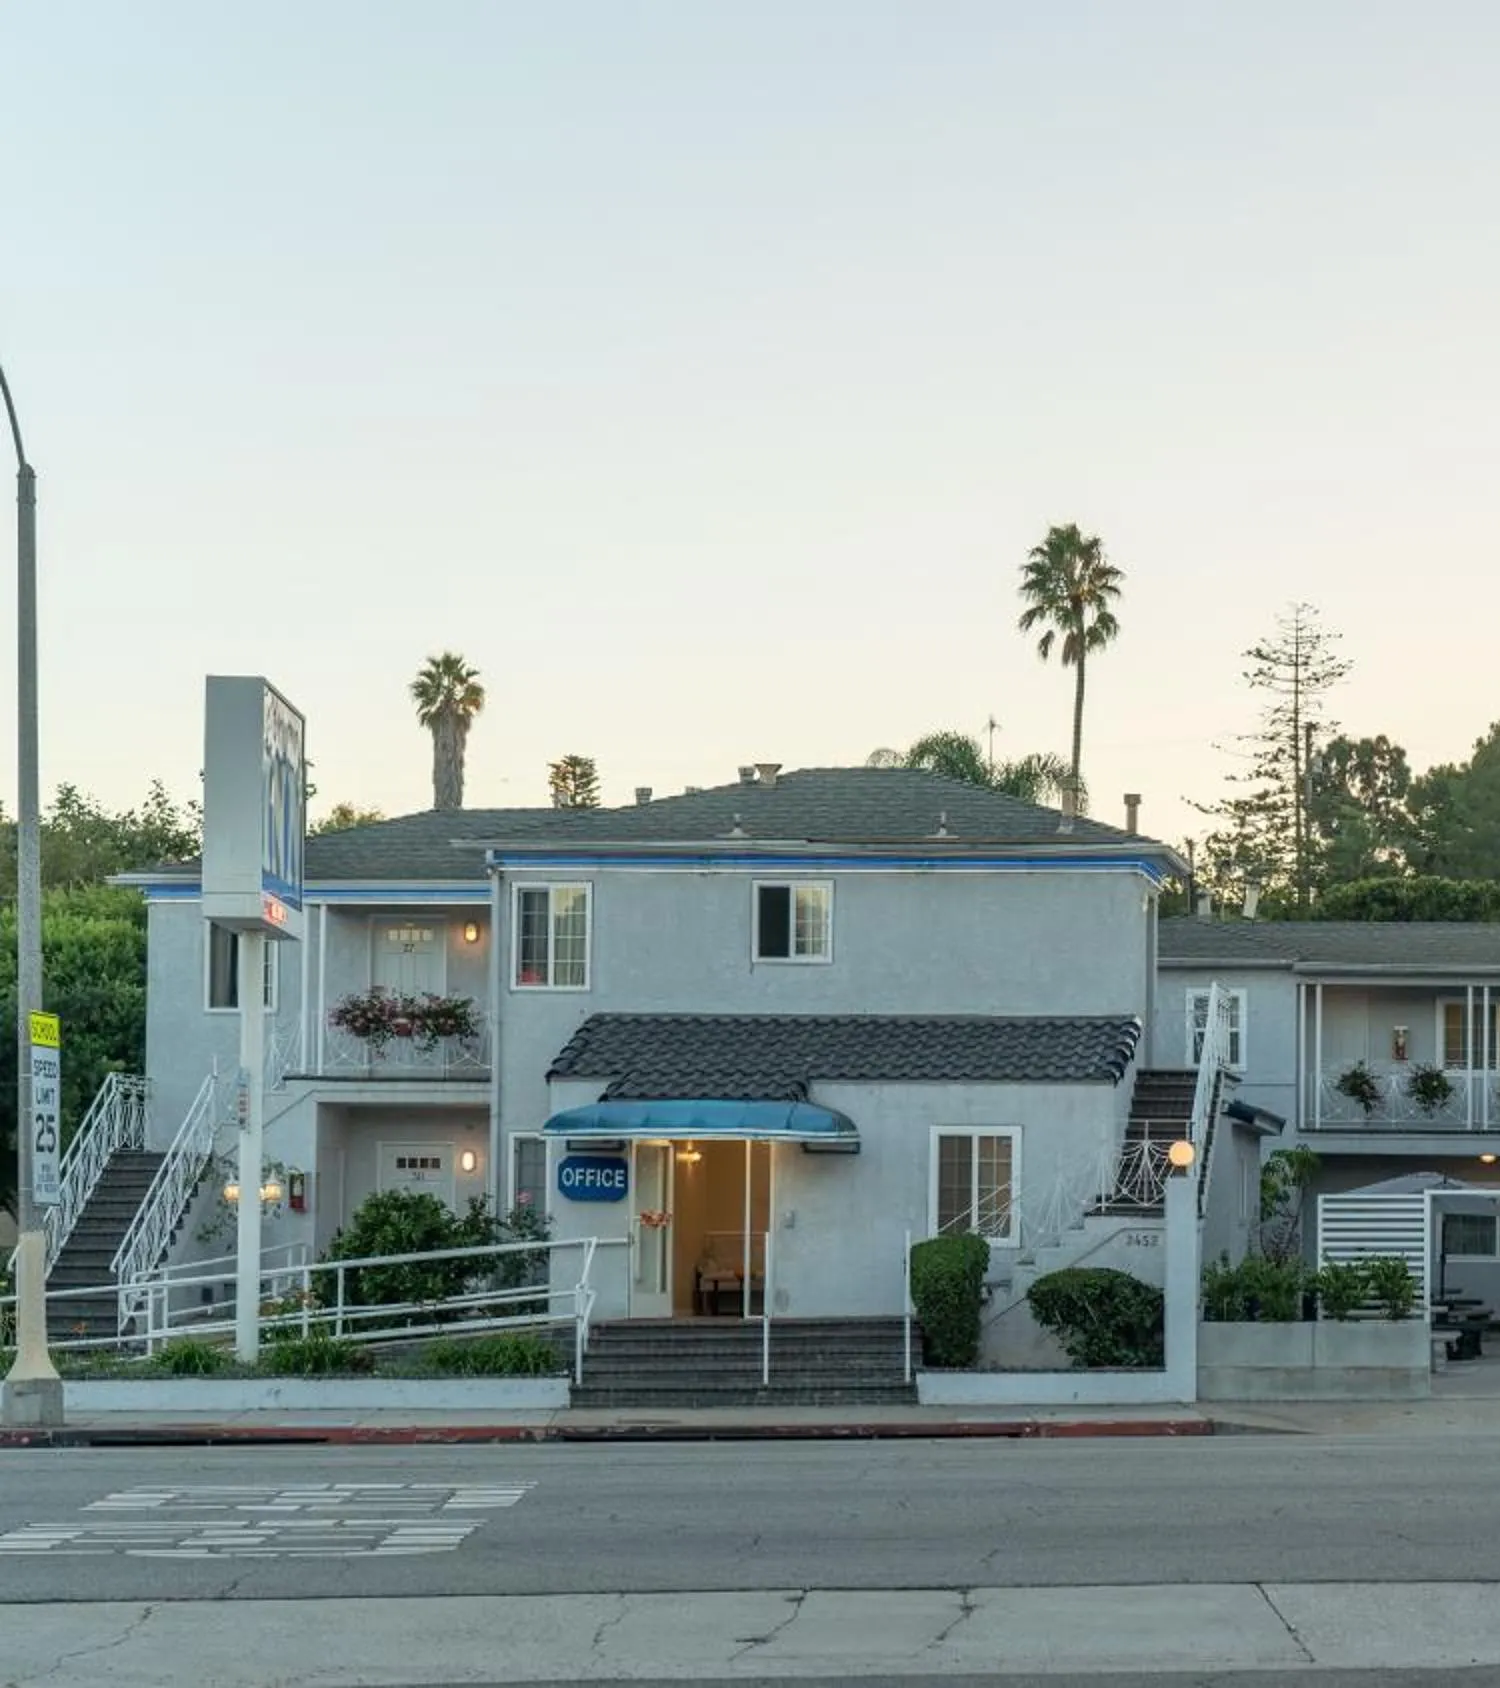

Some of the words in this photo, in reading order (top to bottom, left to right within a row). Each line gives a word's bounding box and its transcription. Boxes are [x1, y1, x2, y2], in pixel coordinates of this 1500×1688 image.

[33, 1060, 57, 1079] SPEED
[36, 1113, 56, 1153] 25
[561, 1167, 625, 1188] OFFICE
